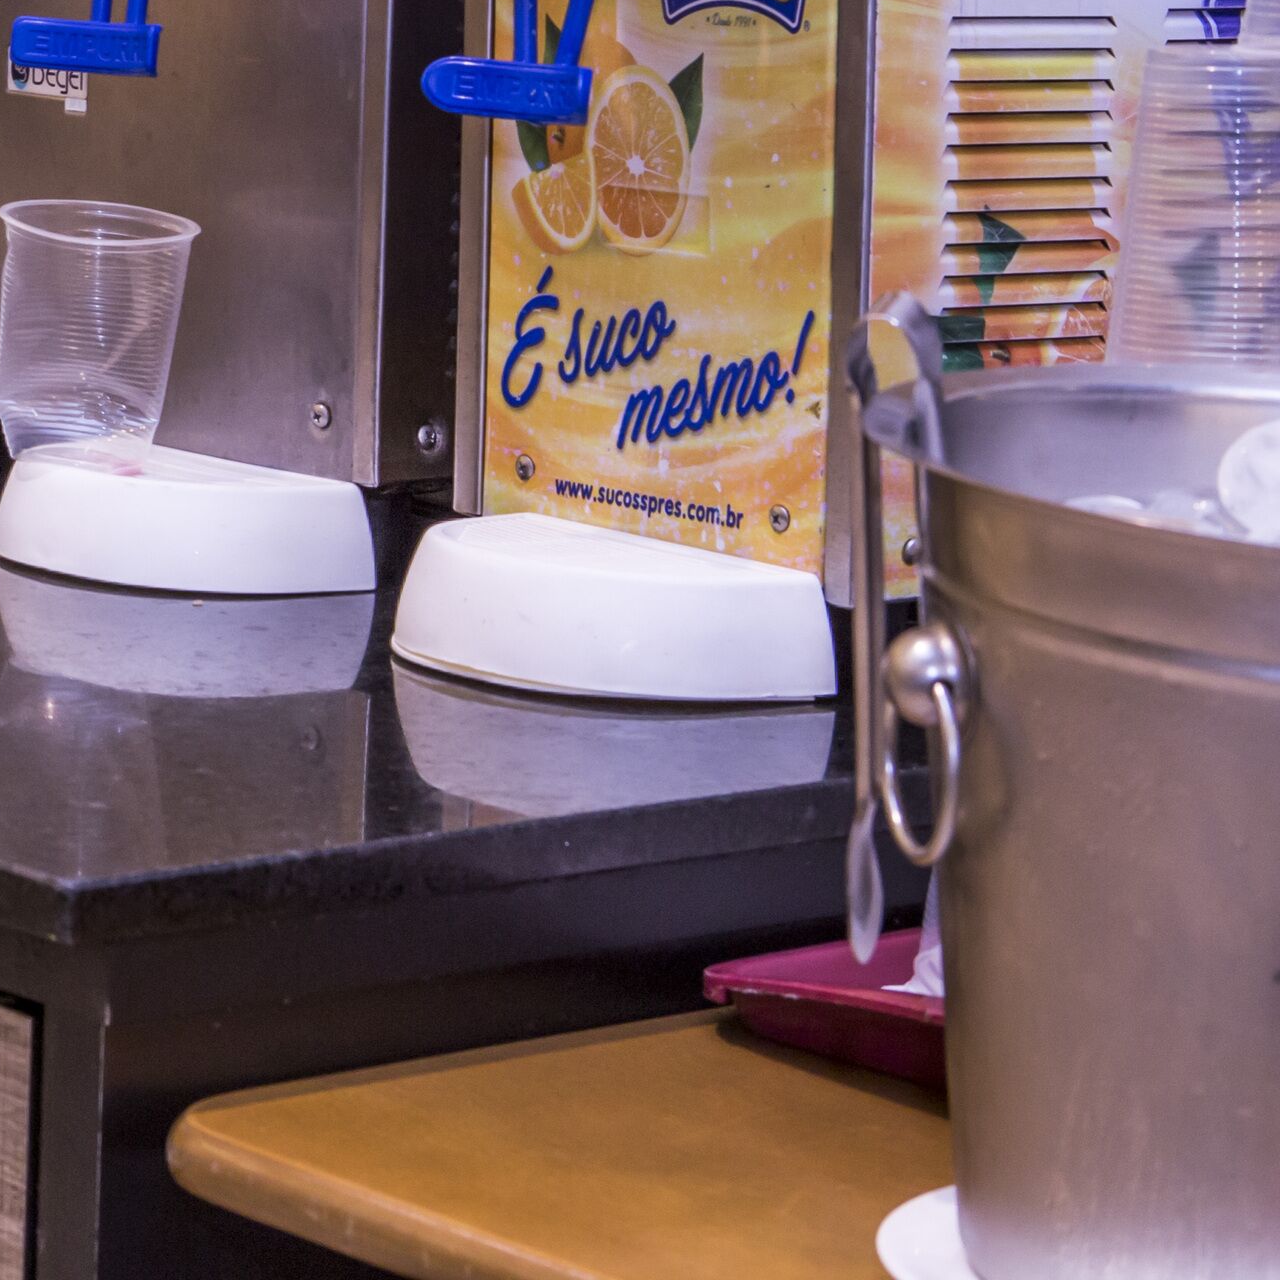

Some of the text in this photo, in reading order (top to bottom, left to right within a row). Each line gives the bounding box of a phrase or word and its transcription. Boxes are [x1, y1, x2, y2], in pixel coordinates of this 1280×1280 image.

[501, 265, 677, 409] É suco
[615, 309, 816, 451] mesmo!
[555, 478, 745, 529] www.sucosspres.com.br
